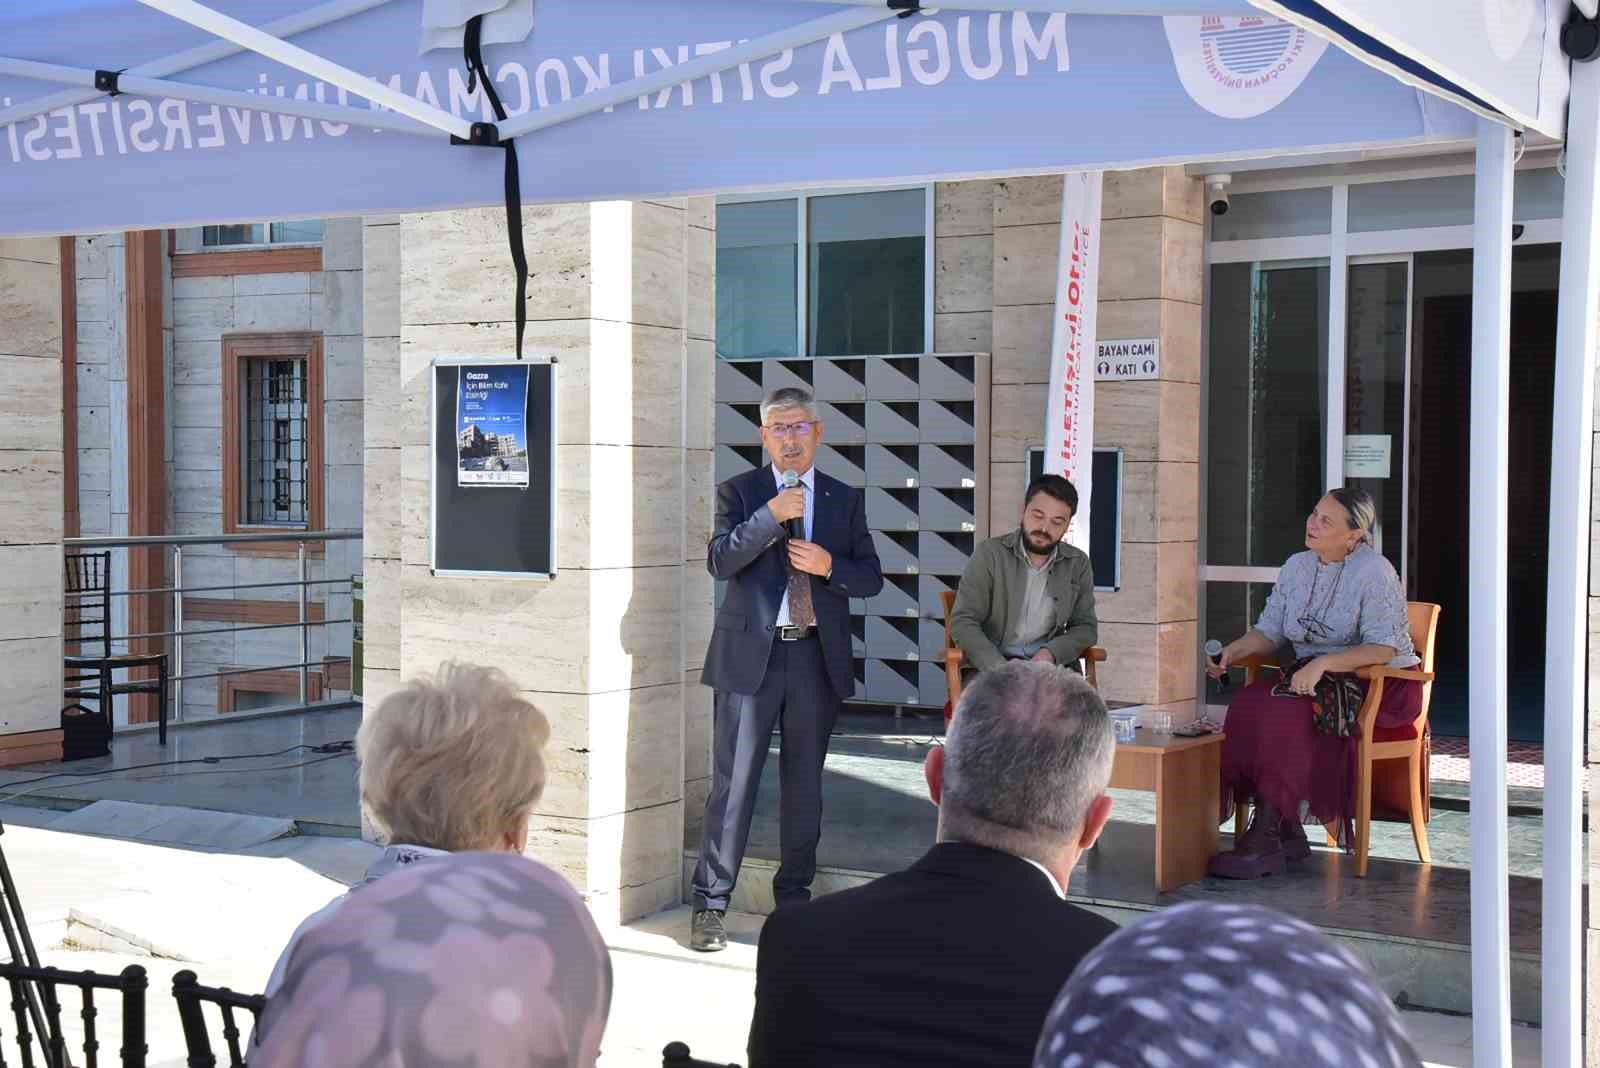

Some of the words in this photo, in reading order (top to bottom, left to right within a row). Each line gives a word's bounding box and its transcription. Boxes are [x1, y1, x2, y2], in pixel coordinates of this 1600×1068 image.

[1098, 345, 1129, 357] BAYAN
[1131, 340, 1155, 356] CAMİ
[1115, 363, 1137, 375] KATI
